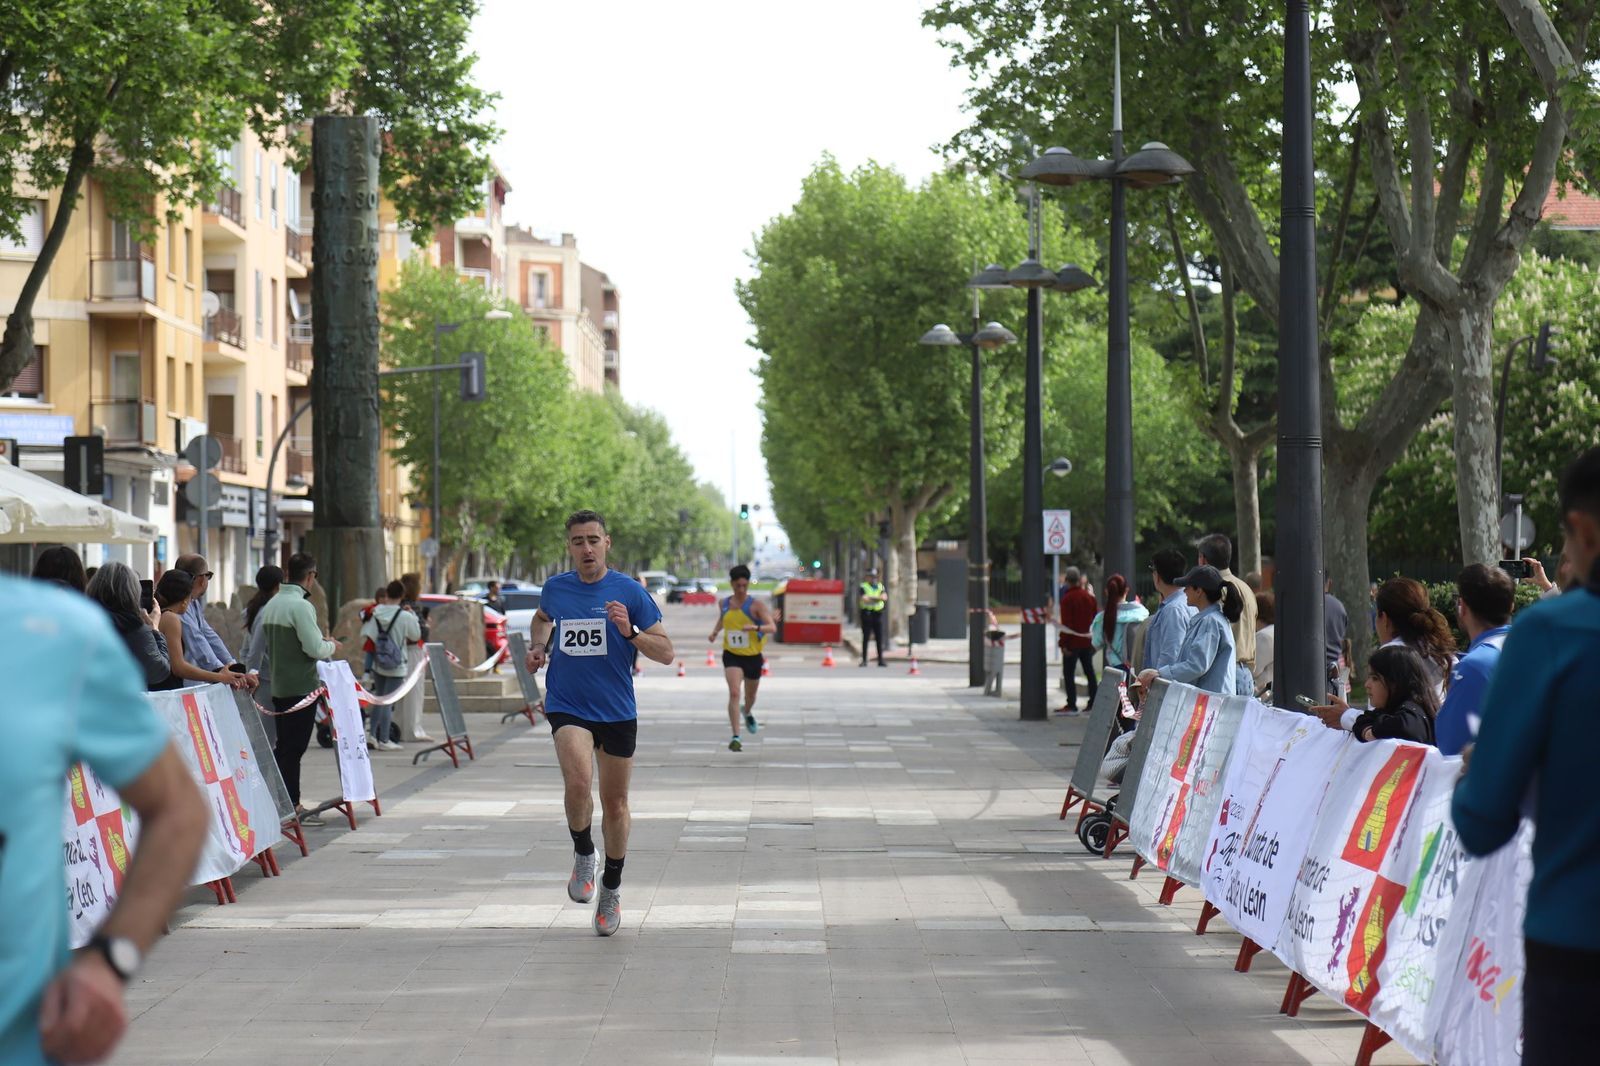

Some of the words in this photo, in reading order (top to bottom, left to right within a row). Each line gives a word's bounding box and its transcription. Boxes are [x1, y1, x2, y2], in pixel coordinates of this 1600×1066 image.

[564, 629, 603, 647] 205
[731, 635, 742, 645] 11
[1262, 831, 1279, 869] de
[1243, 876, 1267, 922] León
